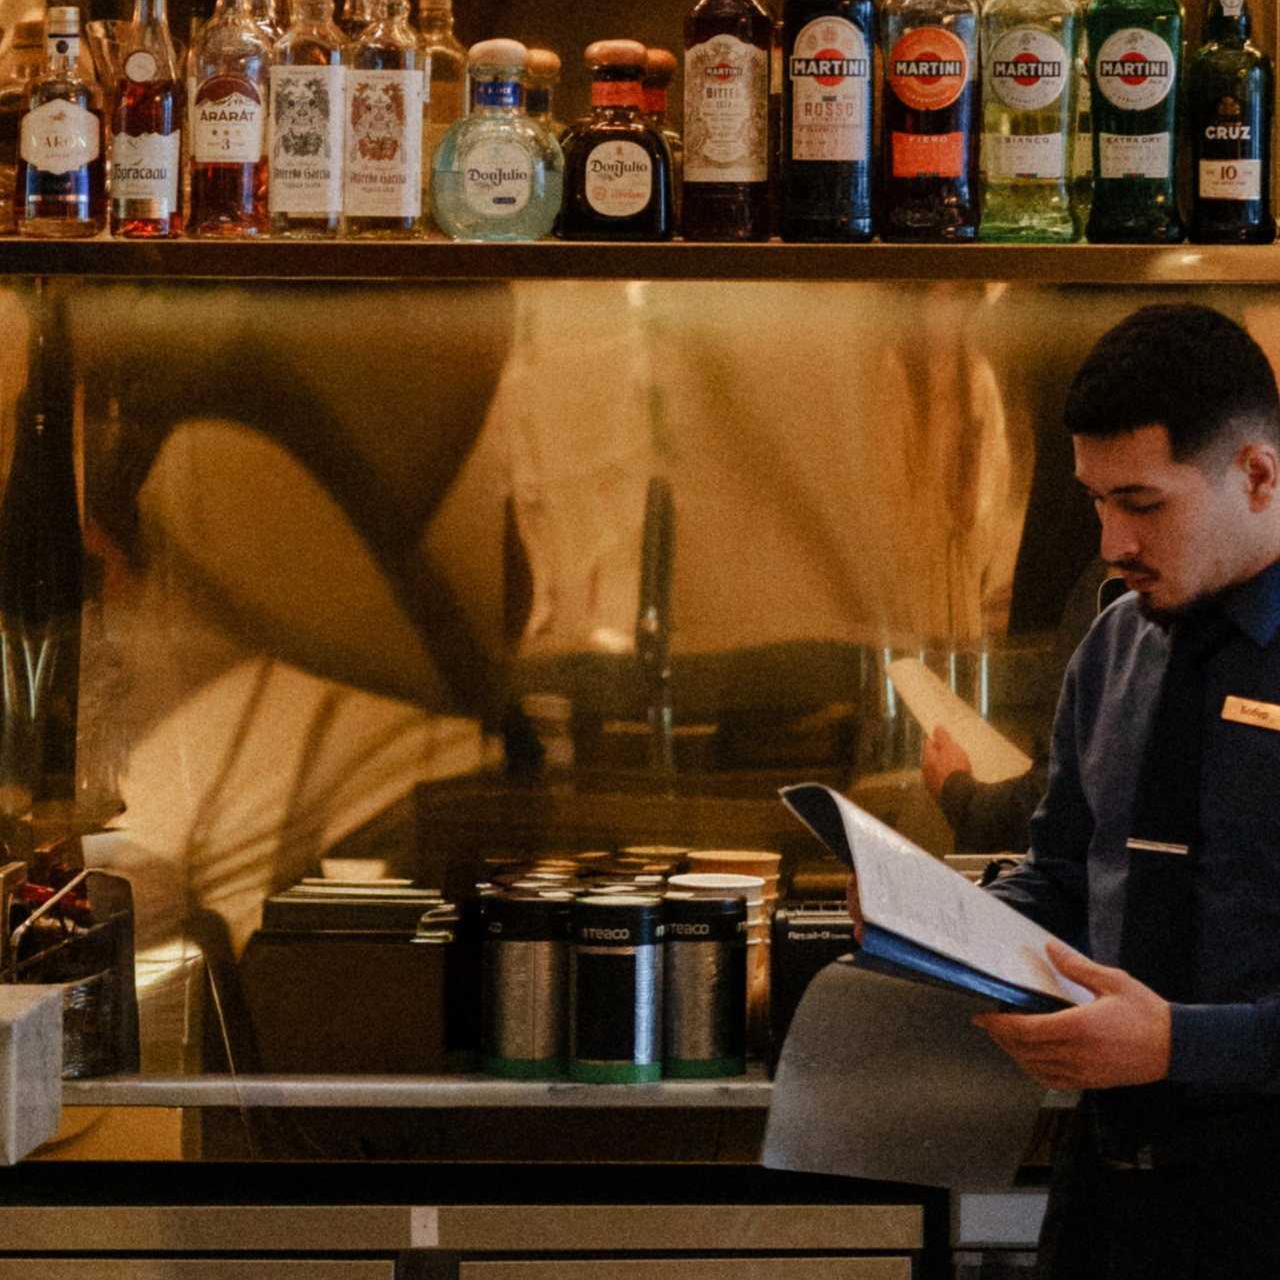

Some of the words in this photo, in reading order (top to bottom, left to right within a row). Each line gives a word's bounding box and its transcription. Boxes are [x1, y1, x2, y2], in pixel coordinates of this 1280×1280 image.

[793, 59, 866, 76] MARTINI
[896, 61, 961, 75] MARTINI
[994, 62, 1060, 77] MARTINI
[1101, 62, 1167, 76] MARTINI
[200, 108, 256, 122] ARARAT
[804, 102, 854, 117] ROSSO
[1205, 126, 1252, 140] CRUZ
[1005, 137, 1049, 145] BIANCO
[1220, 164, 1237, 180] 10
